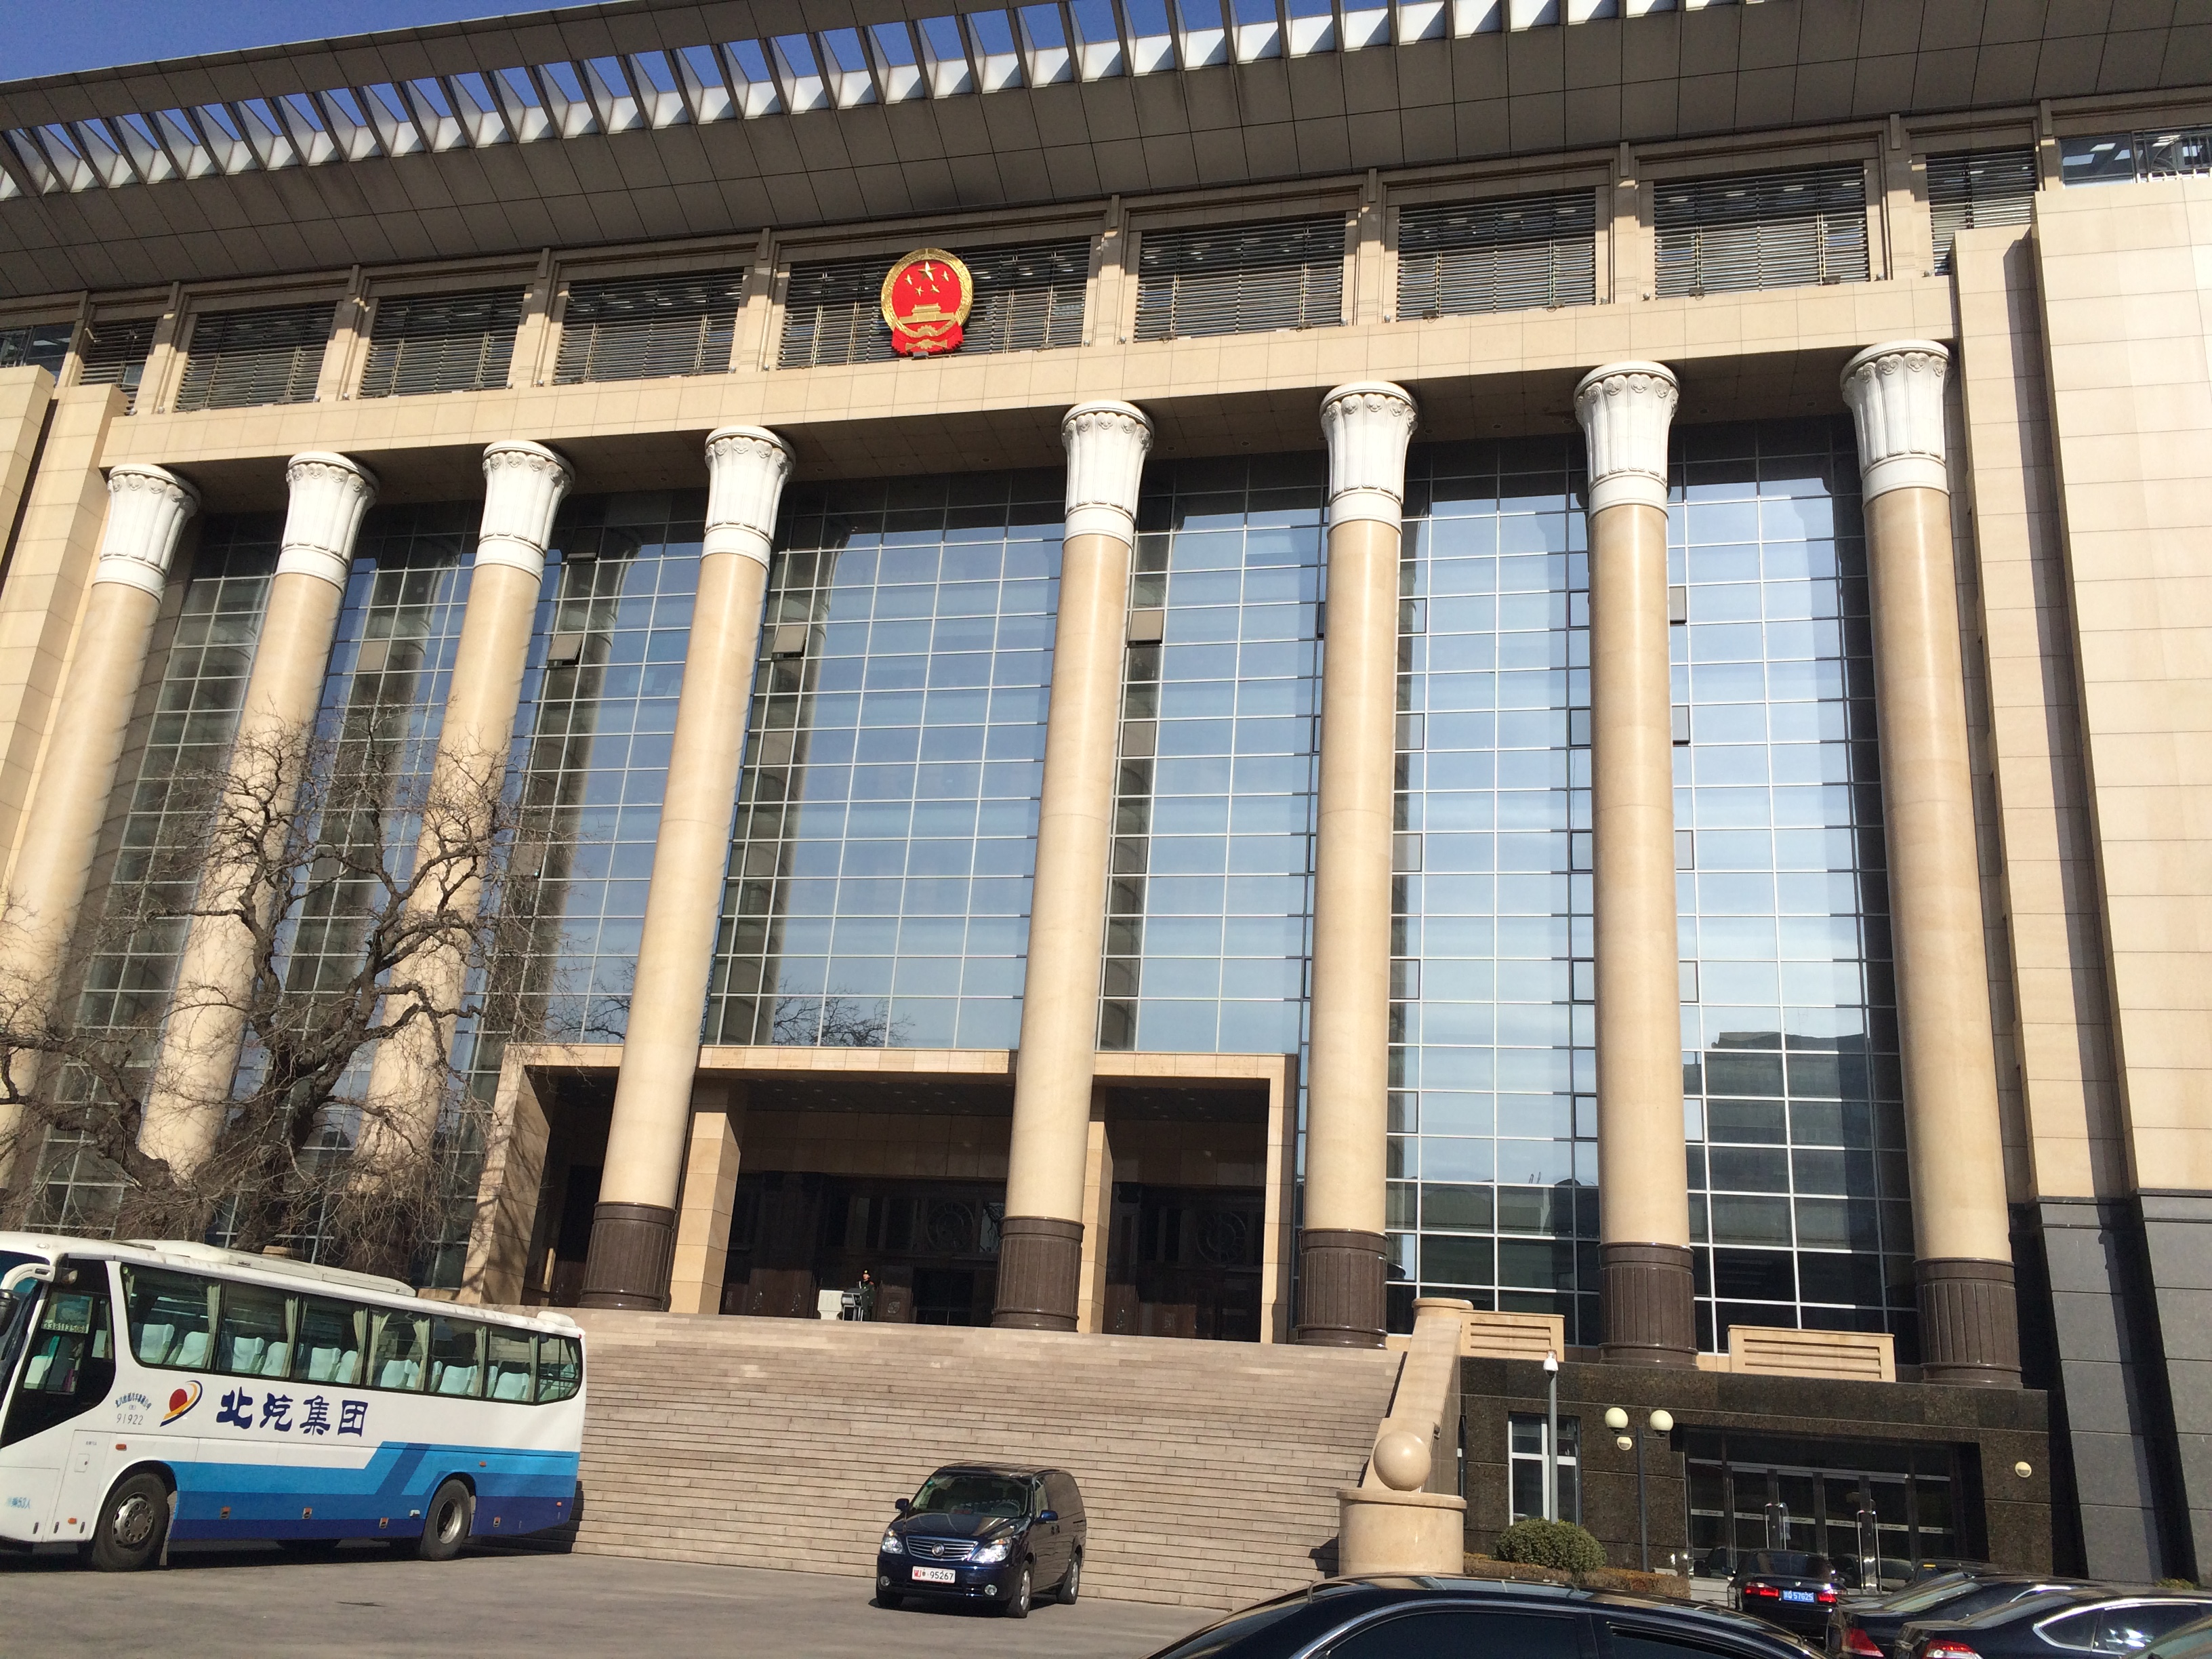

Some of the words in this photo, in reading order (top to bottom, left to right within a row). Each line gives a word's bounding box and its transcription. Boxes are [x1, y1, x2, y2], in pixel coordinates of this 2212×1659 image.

[216, 1386, 369, 1437] 北汽集团
[116, 1413, 144, 1425] 91922
[929, 1571, 954, 1580] 95267
